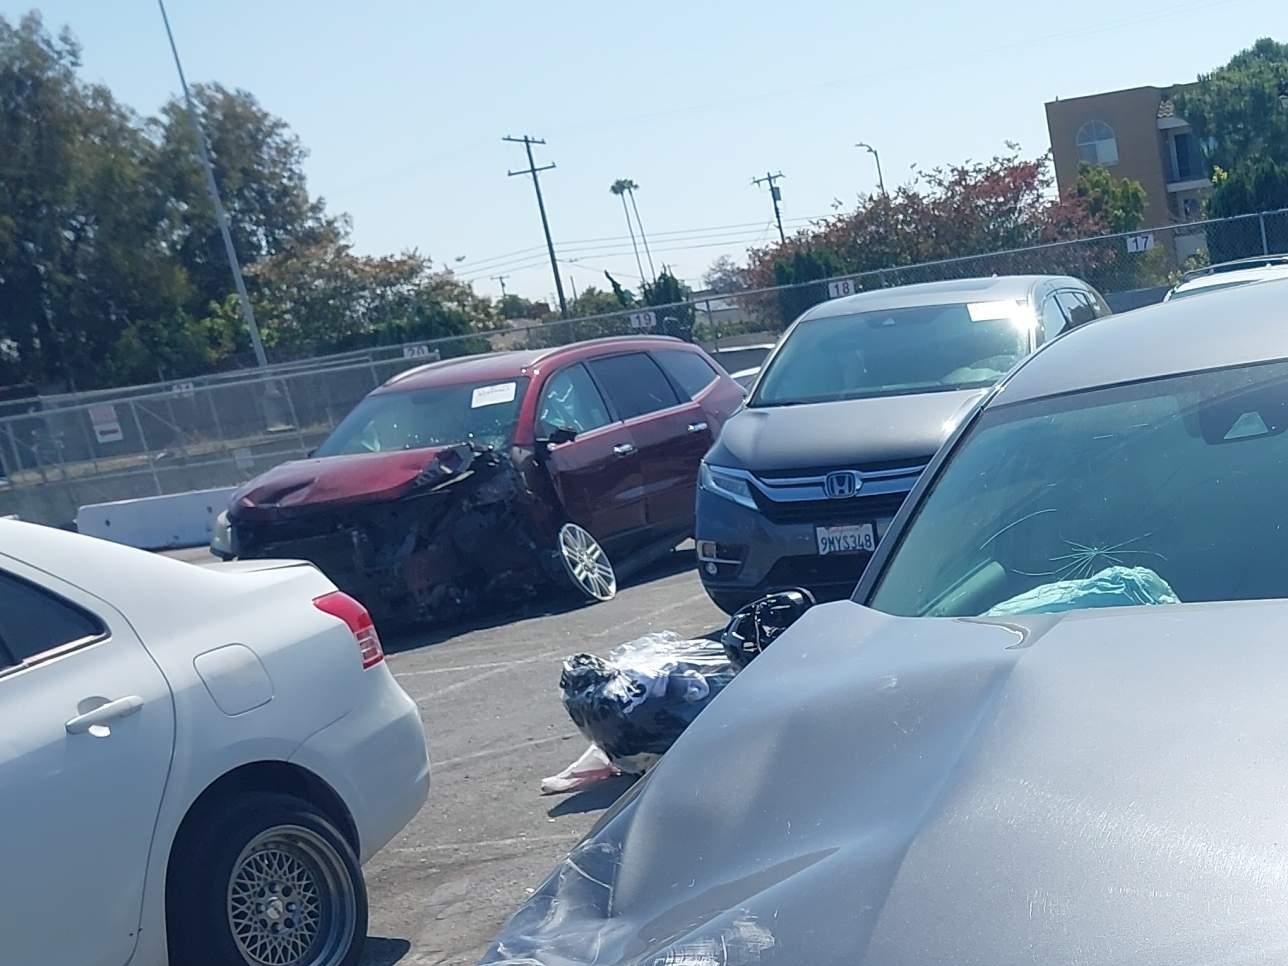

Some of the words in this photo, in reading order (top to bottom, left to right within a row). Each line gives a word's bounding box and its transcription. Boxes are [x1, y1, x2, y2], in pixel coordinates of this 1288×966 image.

[1132, 235, 1149, 250] 17
[834, 281, 850, 297] 18
[635, 311, 652, 328] 19
